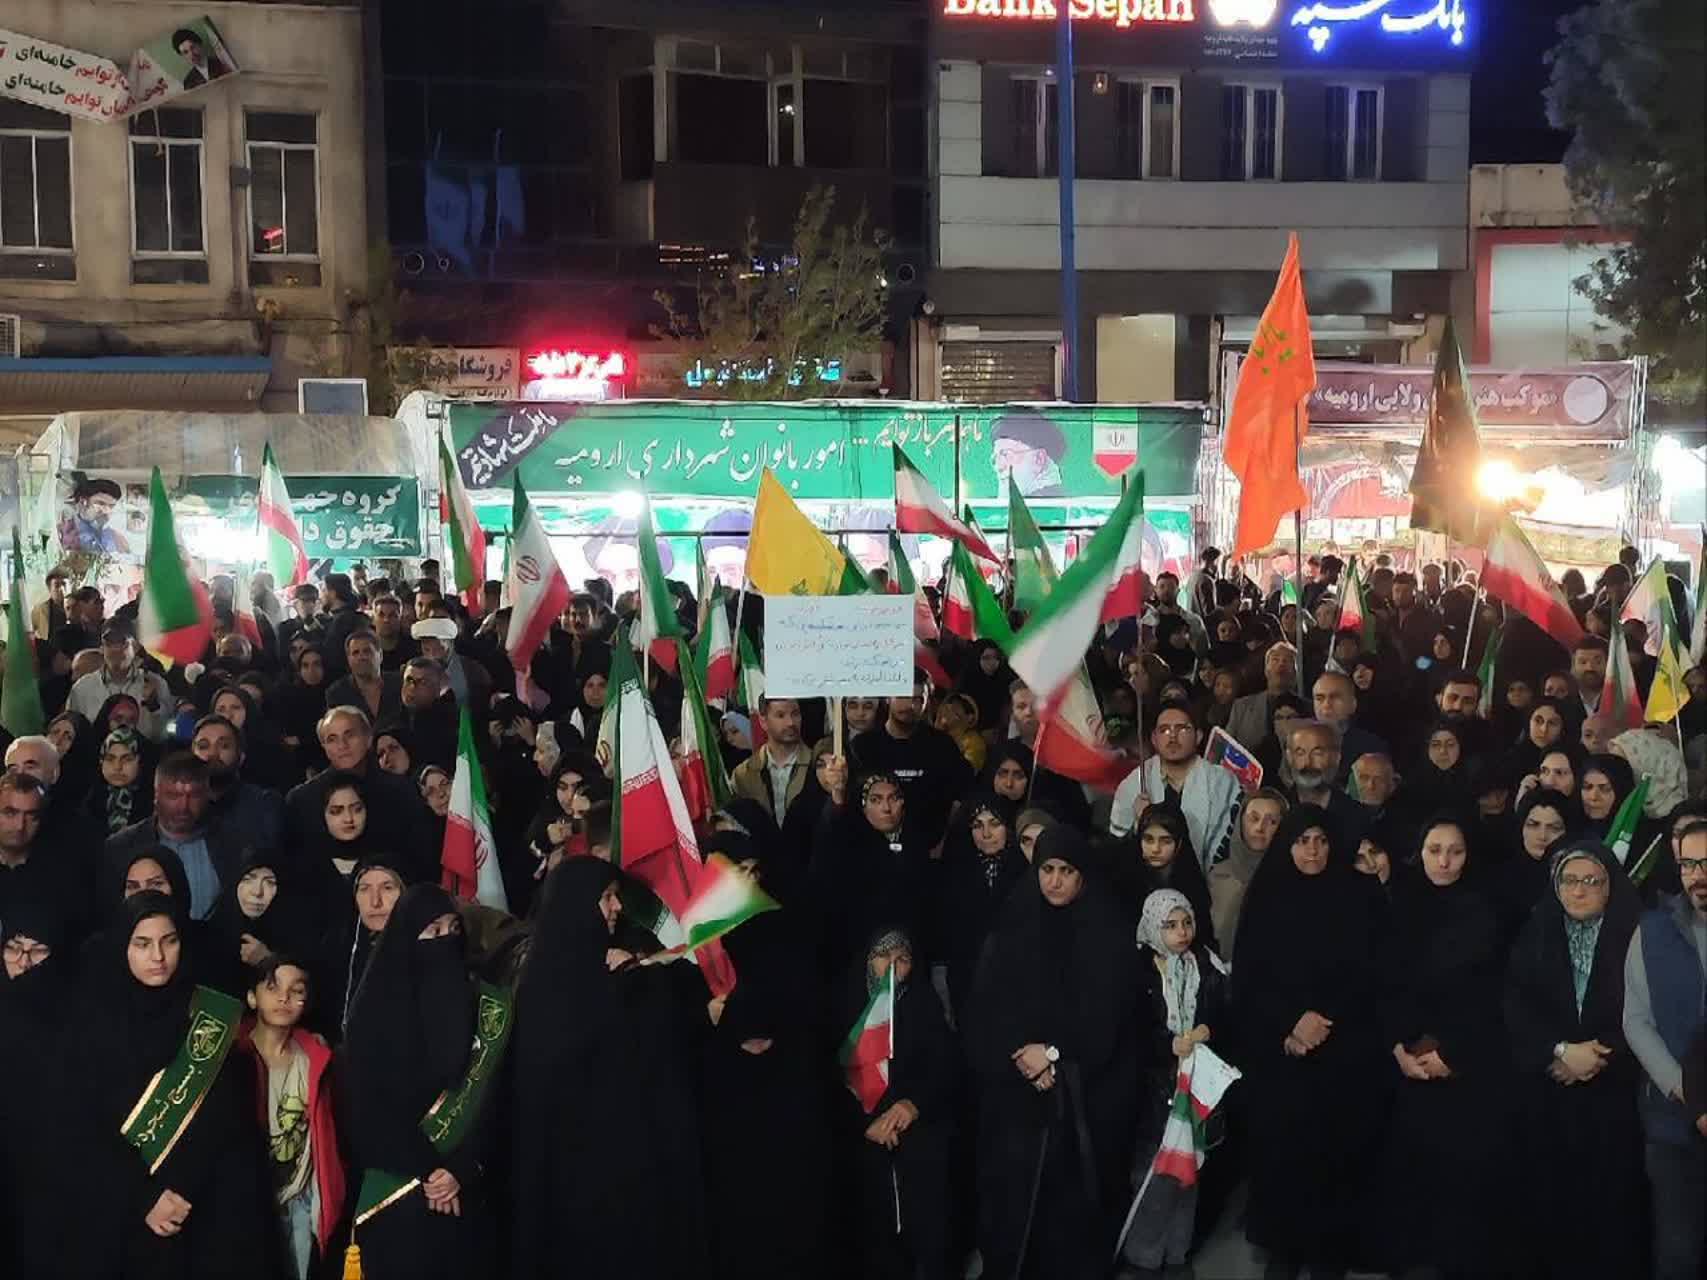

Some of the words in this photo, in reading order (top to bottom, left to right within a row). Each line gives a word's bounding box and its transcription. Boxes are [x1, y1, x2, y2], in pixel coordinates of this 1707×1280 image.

[555, 439, 624, 486] ارومیه
[730, 422, 800, 490] بانوان
[803, 439, 846, 470] امور
[325, 516, 395, 549] حقوق
